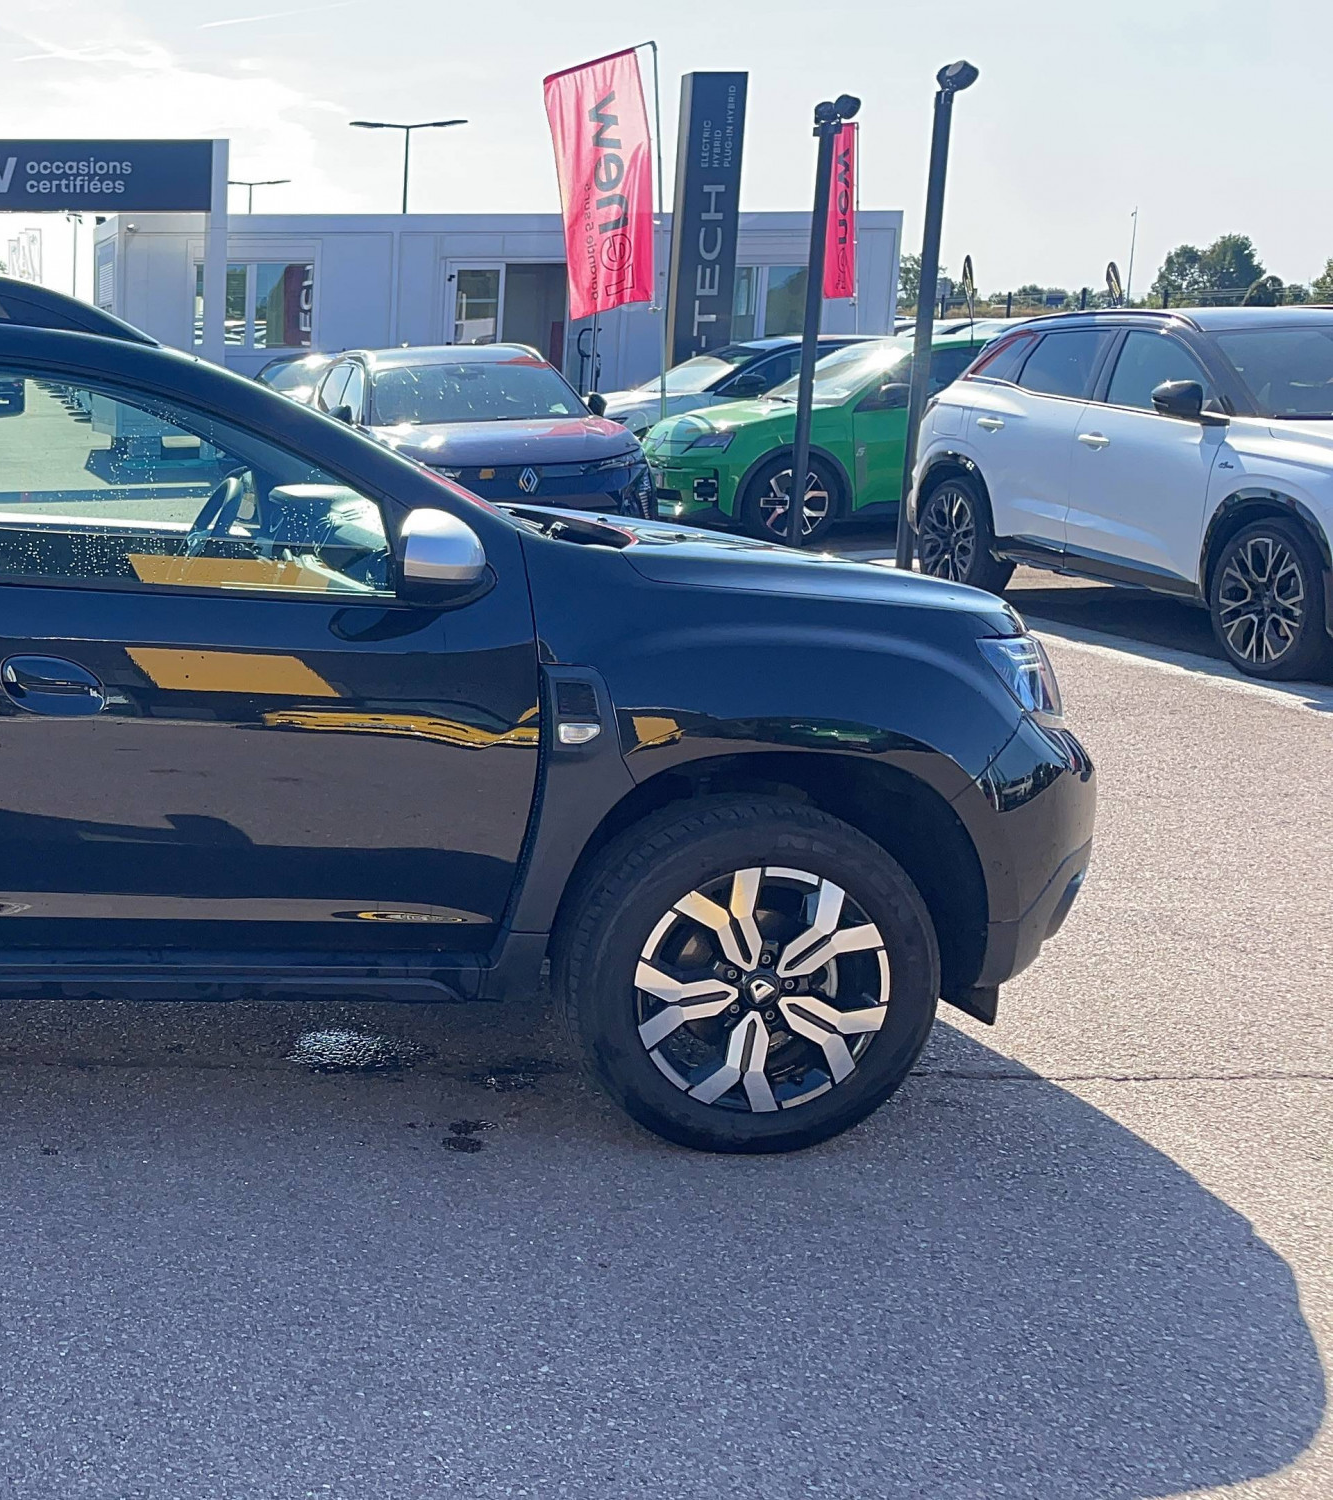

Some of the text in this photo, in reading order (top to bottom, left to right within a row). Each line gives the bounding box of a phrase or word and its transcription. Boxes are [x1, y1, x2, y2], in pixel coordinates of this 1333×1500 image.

[700, 119, 712, 168] ELECTRIC
[712, 129, 722, 168] HYBRID
[723, 85, 737, 168] PLUG-IN HYBRID
[26, 157, 133, 175] occasions
[26, 176, 126, 194] certifiées
[691, 184, 726, 358] -TECH
